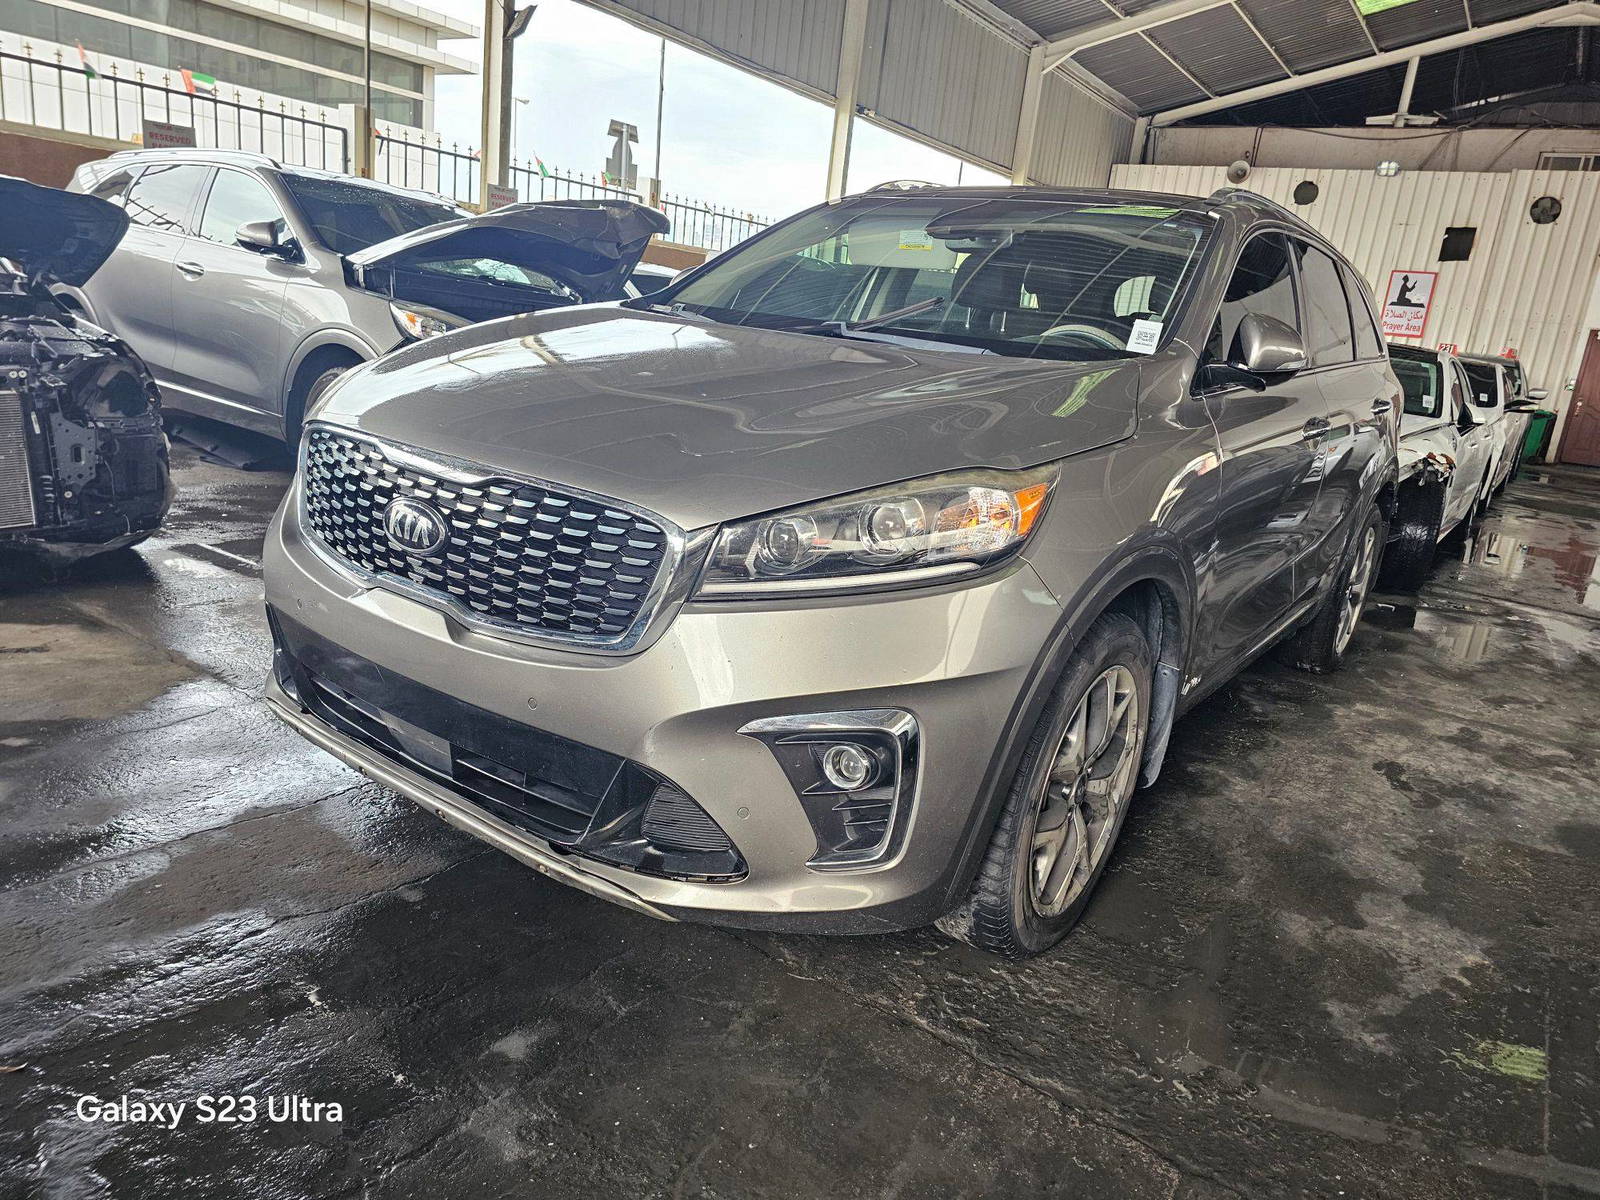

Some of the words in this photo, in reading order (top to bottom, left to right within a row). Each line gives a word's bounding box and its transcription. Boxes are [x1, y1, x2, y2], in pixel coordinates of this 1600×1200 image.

[1382, 321, 1404, 332] Prayer
[1405, 322, 1421, 332] Area
[389, 503, 432, 546] KIA
